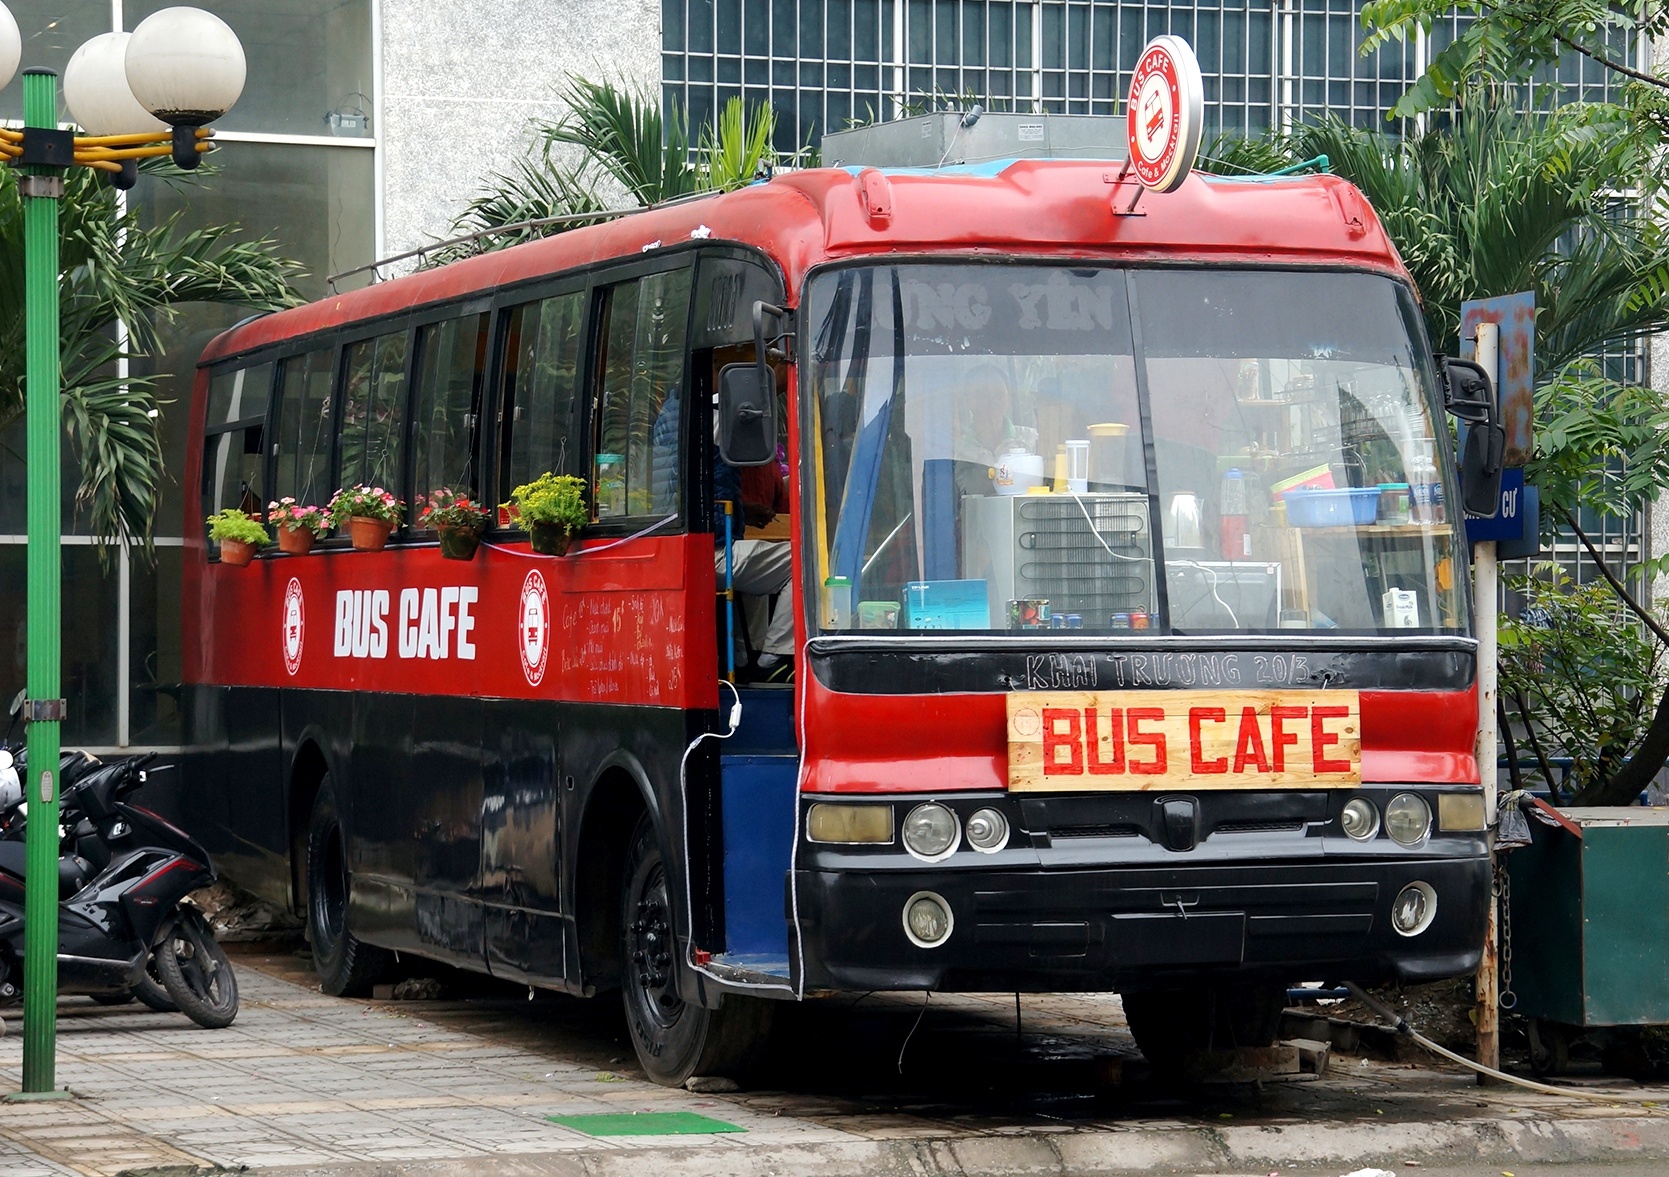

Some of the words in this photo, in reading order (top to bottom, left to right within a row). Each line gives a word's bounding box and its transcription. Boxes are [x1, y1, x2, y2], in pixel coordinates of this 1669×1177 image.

[1130, 70, 1146, 112] BUS
[1145, 53, 1169, 73] CAFE
[1137, 160, 1153, 179] Cafe
[1153, 166, 1160, 178] &
[1160, 113, 1180, 171] Mocktail
[1502, 487, 1518, 518] CƯ
[333, 589, 390, 659] BUS
[398, 586, 479, 660] CAFE
[1026, 654, 1098, 690] KHAI
[1106, 652, 1242, 687] TRƯƠNG
[1254, 655, 1311, 685] 20/3
[1042, 707, 1168, 776] BUS
[1188, 706, 1351, 775] CAFE
